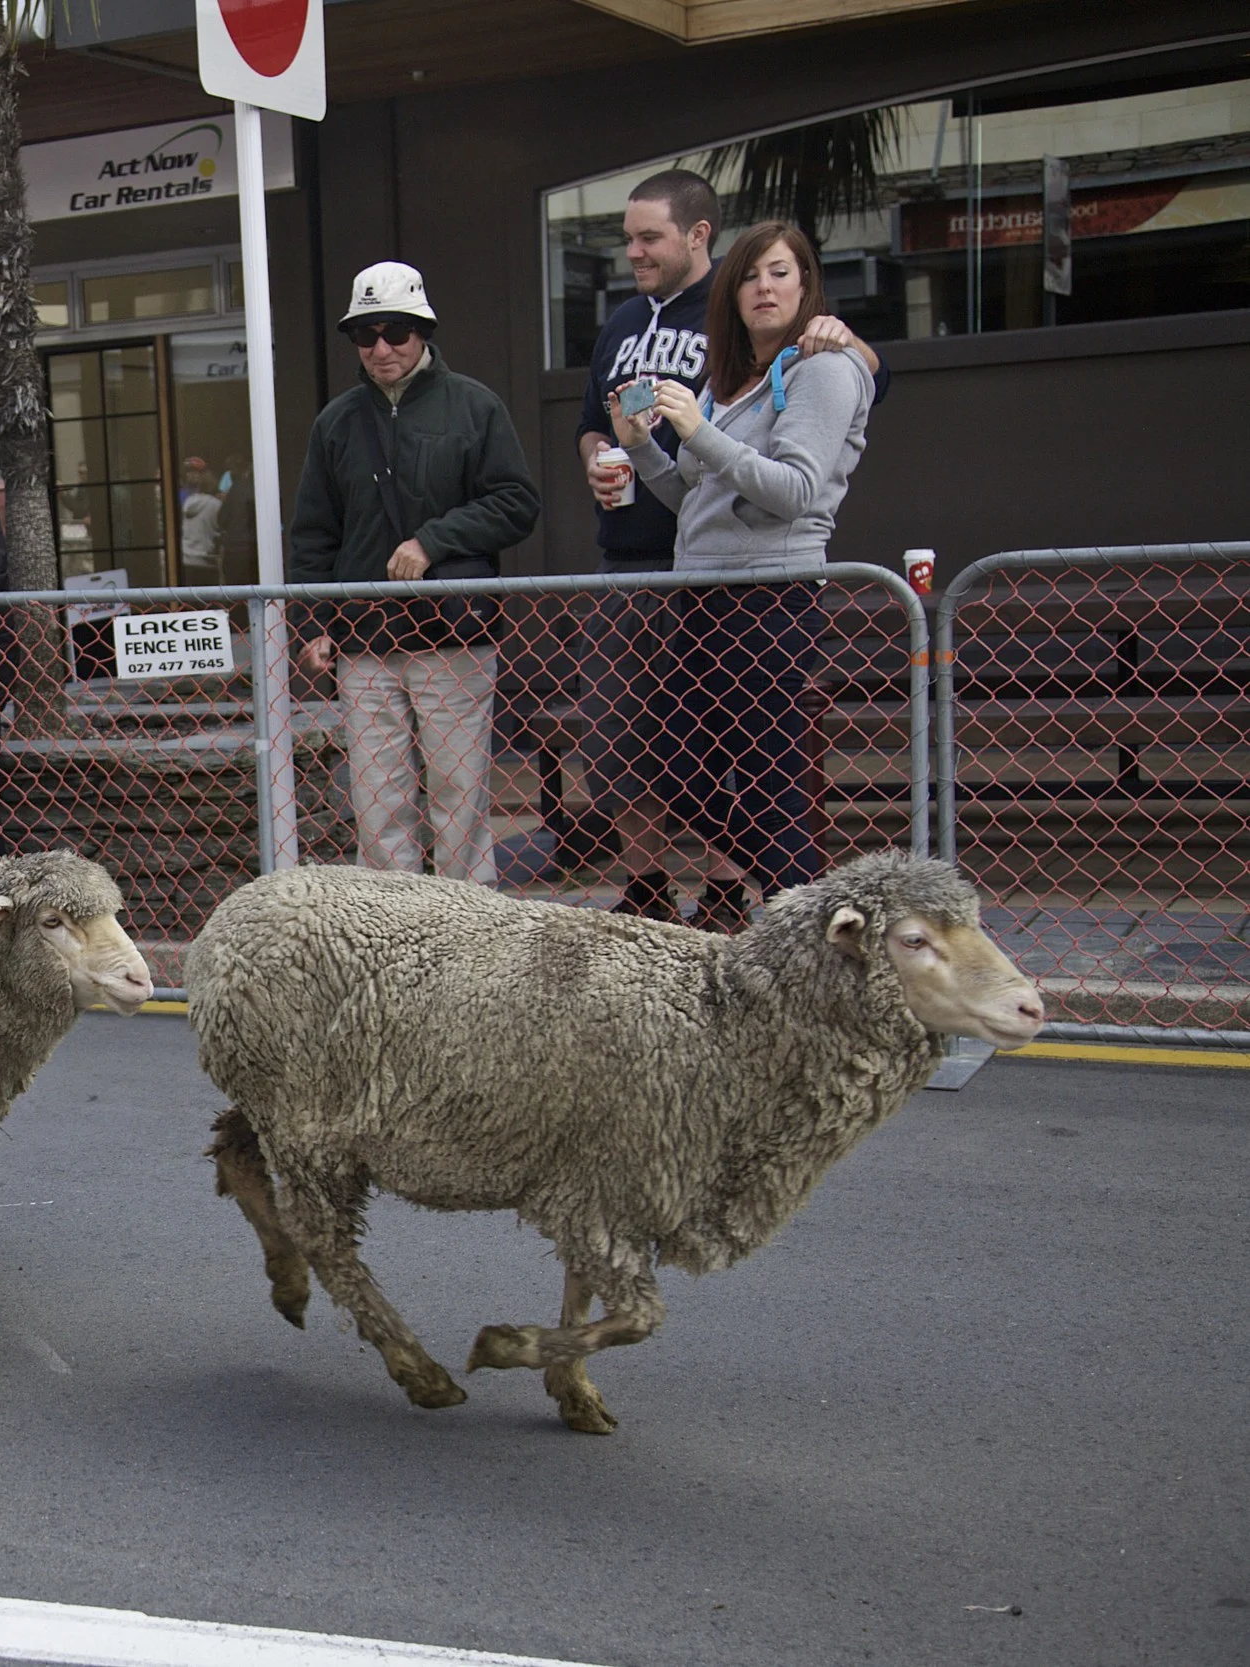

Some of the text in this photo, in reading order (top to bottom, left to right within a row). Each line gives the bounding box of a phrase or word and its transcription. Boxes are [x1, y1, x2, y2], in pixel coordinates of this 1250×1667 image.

[98, 152, 198, 180] Act Now
[69, 177, 214, 211] Car Rentals
[606, 327, 709, 381] PARIS
[125, 617, 219, 636] LAKES
[125, 637, 223, 655] FENCE HIRE
[128, 658, 225, 673] 027 477 7645
